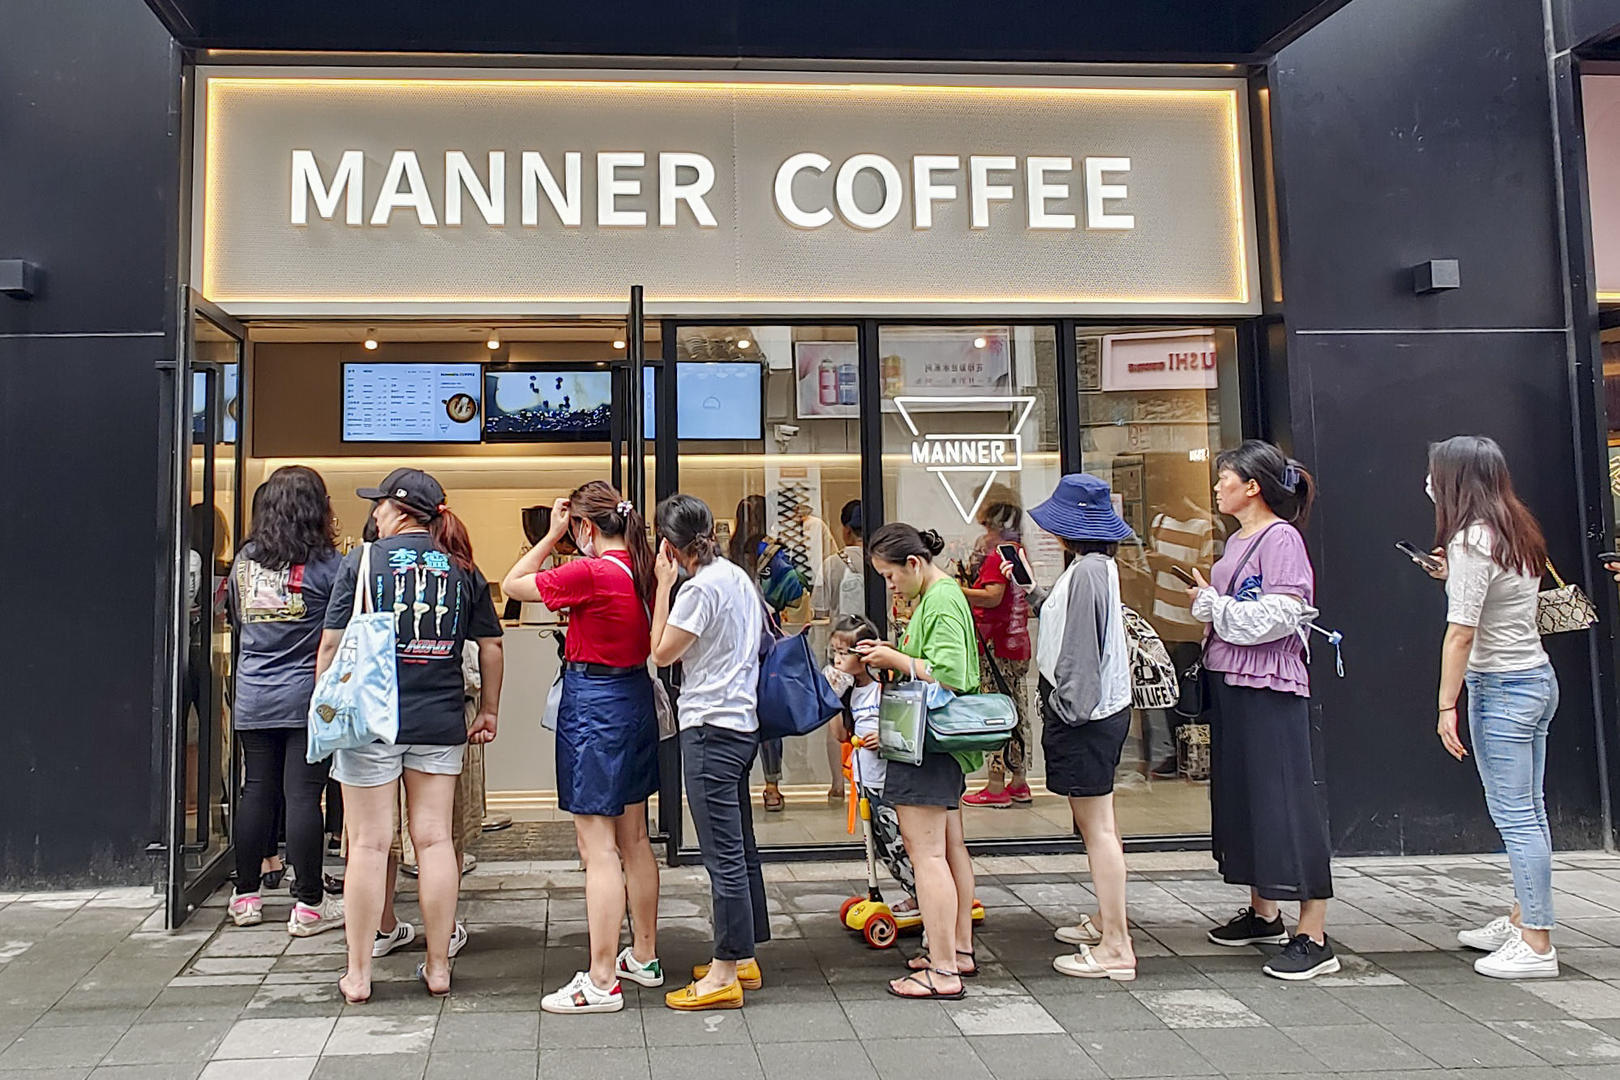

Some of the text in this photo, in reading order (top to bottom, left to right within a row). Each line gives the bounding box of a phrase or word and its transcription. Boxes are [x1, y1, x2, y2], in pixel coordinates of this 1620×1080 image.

[291, 150, 1136, 230] MANNER COFFEE
[911, 440, 1005, 464] MANNER
[1145, 686, 1171, 706] LIFE
